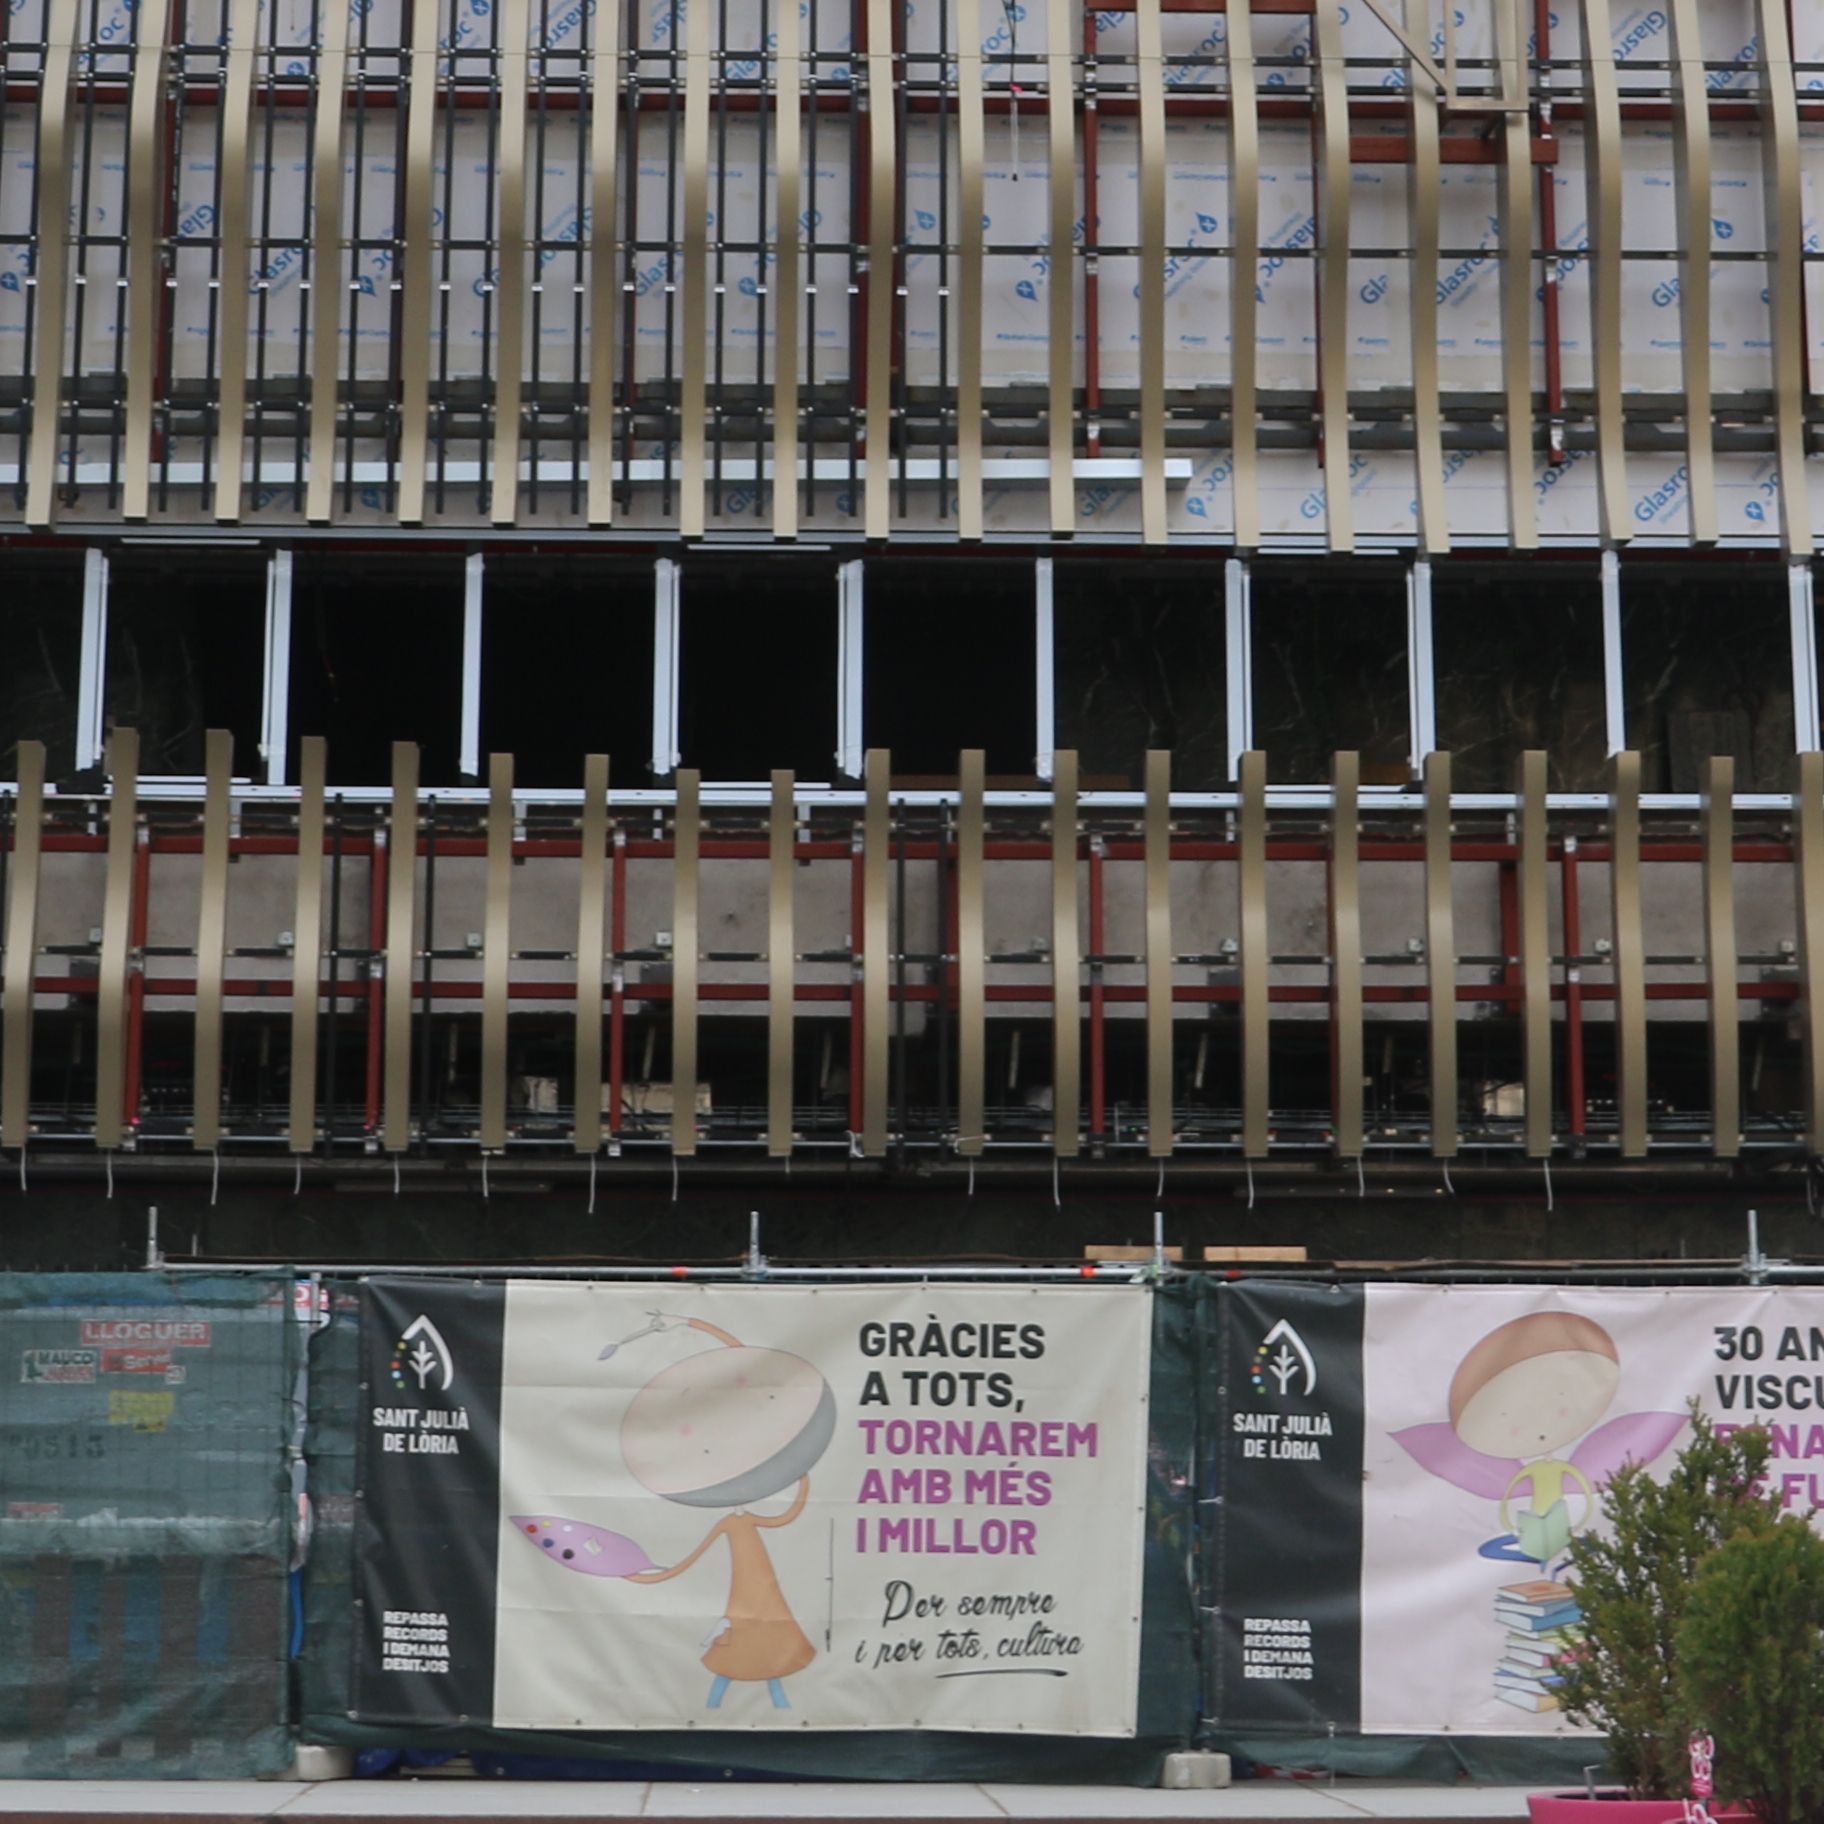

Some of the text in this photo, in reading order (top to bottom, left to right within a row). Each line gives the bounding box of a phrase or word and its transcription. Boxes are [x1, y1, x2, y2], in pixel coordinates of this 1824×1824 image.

[86, 1322, 206, 1340] LLOGUER
[859, 1313, 1045, 1359] GRÀCIES
[1714, 1326, 1763, 1361] 30
[859, 1371, 1024, 1413] A TOTS,
[373, 1406, 469, 1430] SANT JULIÀ
[1233, 1411, 1332, 1435] SANT JULIÀ
[383, 1430, 459, 1454] DE LÒRIA
[858, 1419, 1098, 1457] TORNAREM
[1243, 1436, 1321, 1460] DE LÒRIA
[857, 1461, 1052, 1506] AMB MÉS
[856, 1518, 1037, 1555] I MILLOR
[383, 1610, 449, 1626] REPASSA
[957, 1591, 1057, 1620] sempre
[1243, 1618, 1312, 1633] REPASSA
[854, 1639, 866, 1663] i
[873, 1638, 926, 1669] per
[997, 1621, 1084, 1657] cultura
